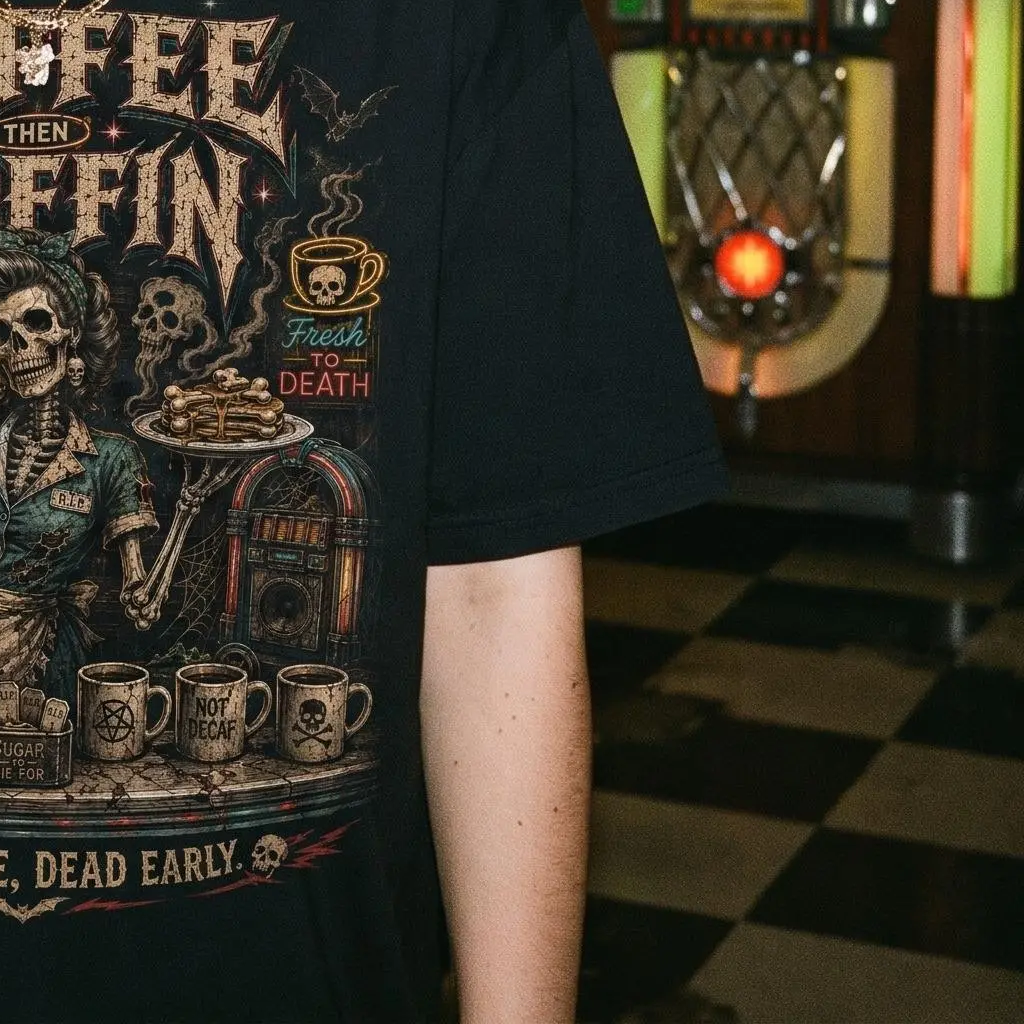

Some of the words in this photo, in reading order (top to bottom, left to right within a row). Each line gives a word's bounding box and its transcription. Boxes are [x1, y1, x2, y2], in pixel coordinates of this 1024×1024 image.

[3, 120, 68, 144] THEN
[282, 316, 368, 349] Fresh
[310, 353, 339, 368] TO
[279, 371, 371, 398] DEATH
[195, 697, 230, 717] NOT
[188, 718, 237, 740] DECAF
[12, 759, 25, 767] TO
[18, 768, 45, 781] FOR
[34, 850, 128, 890] DEAD
[140, 838, 244, 887] EARLY.
